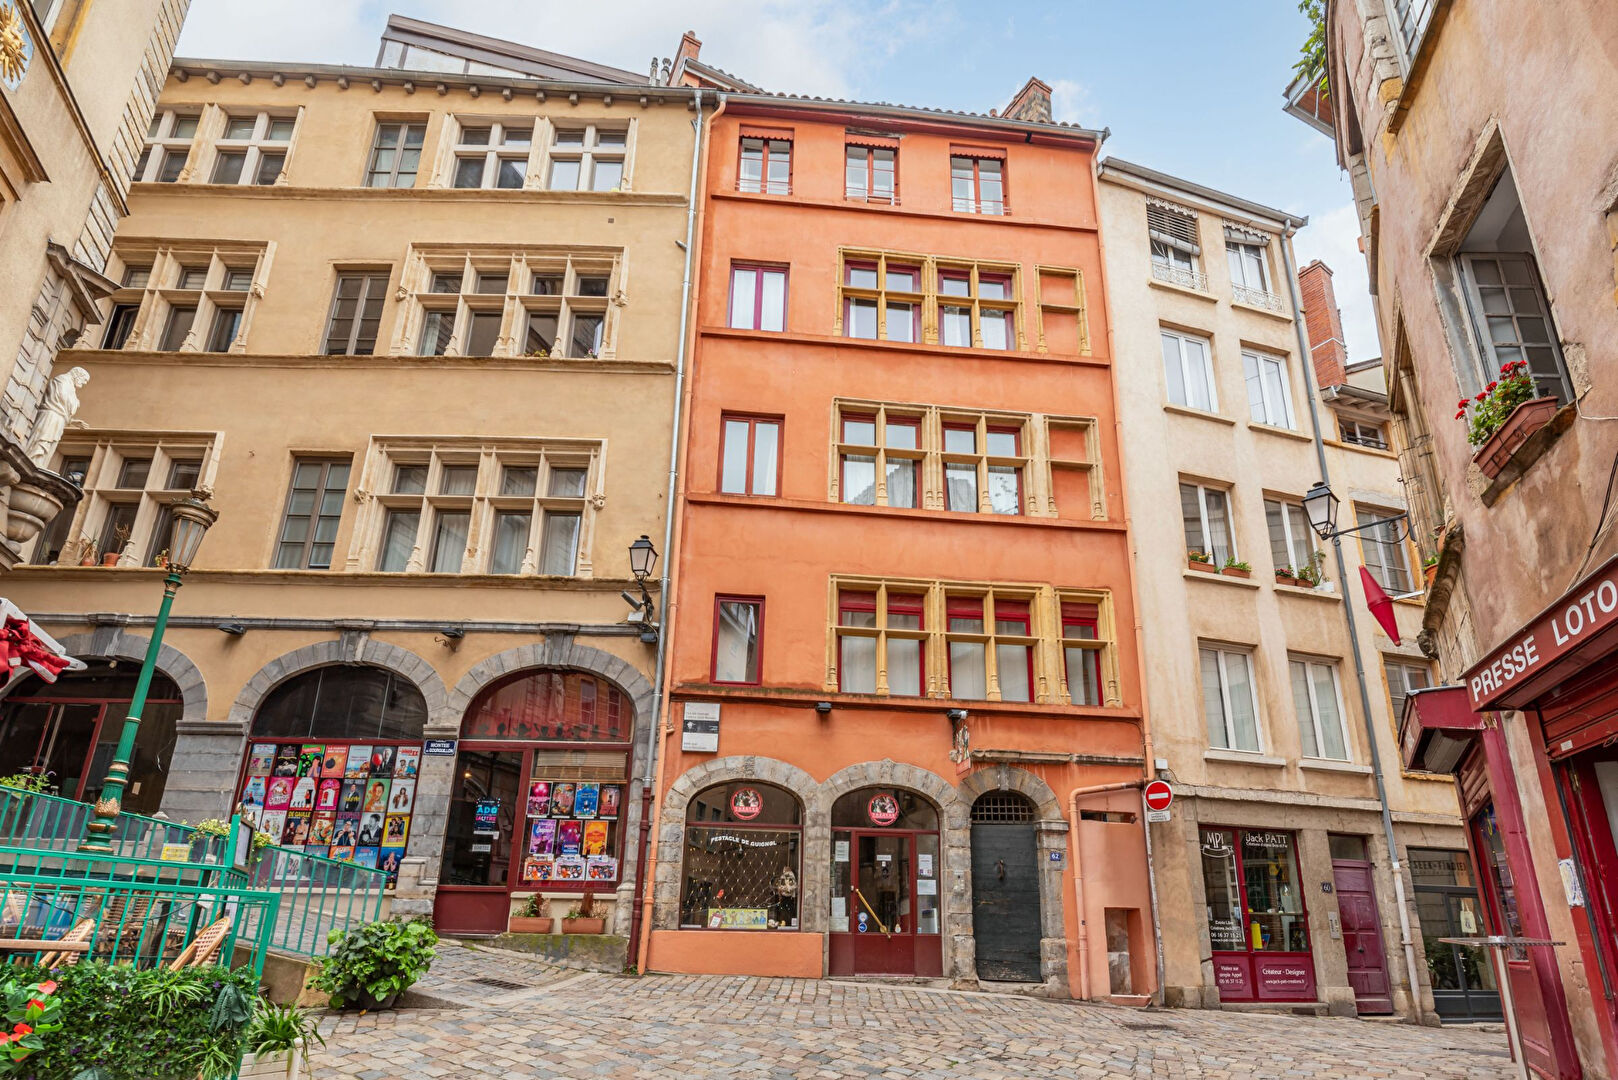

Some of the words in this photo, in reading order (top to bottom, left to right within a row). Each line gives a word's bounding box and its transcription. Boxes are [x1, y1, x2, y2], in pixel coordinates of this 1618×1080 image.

[1471, 635, 1540, 702] PRESSE
[1551, 579, 1617, 647] LOTO
[710, 835, 740, 844] PESTACLE
[1245, 833, 1263, 843] Jack
[1264, 834, 1288, 844] PATT
